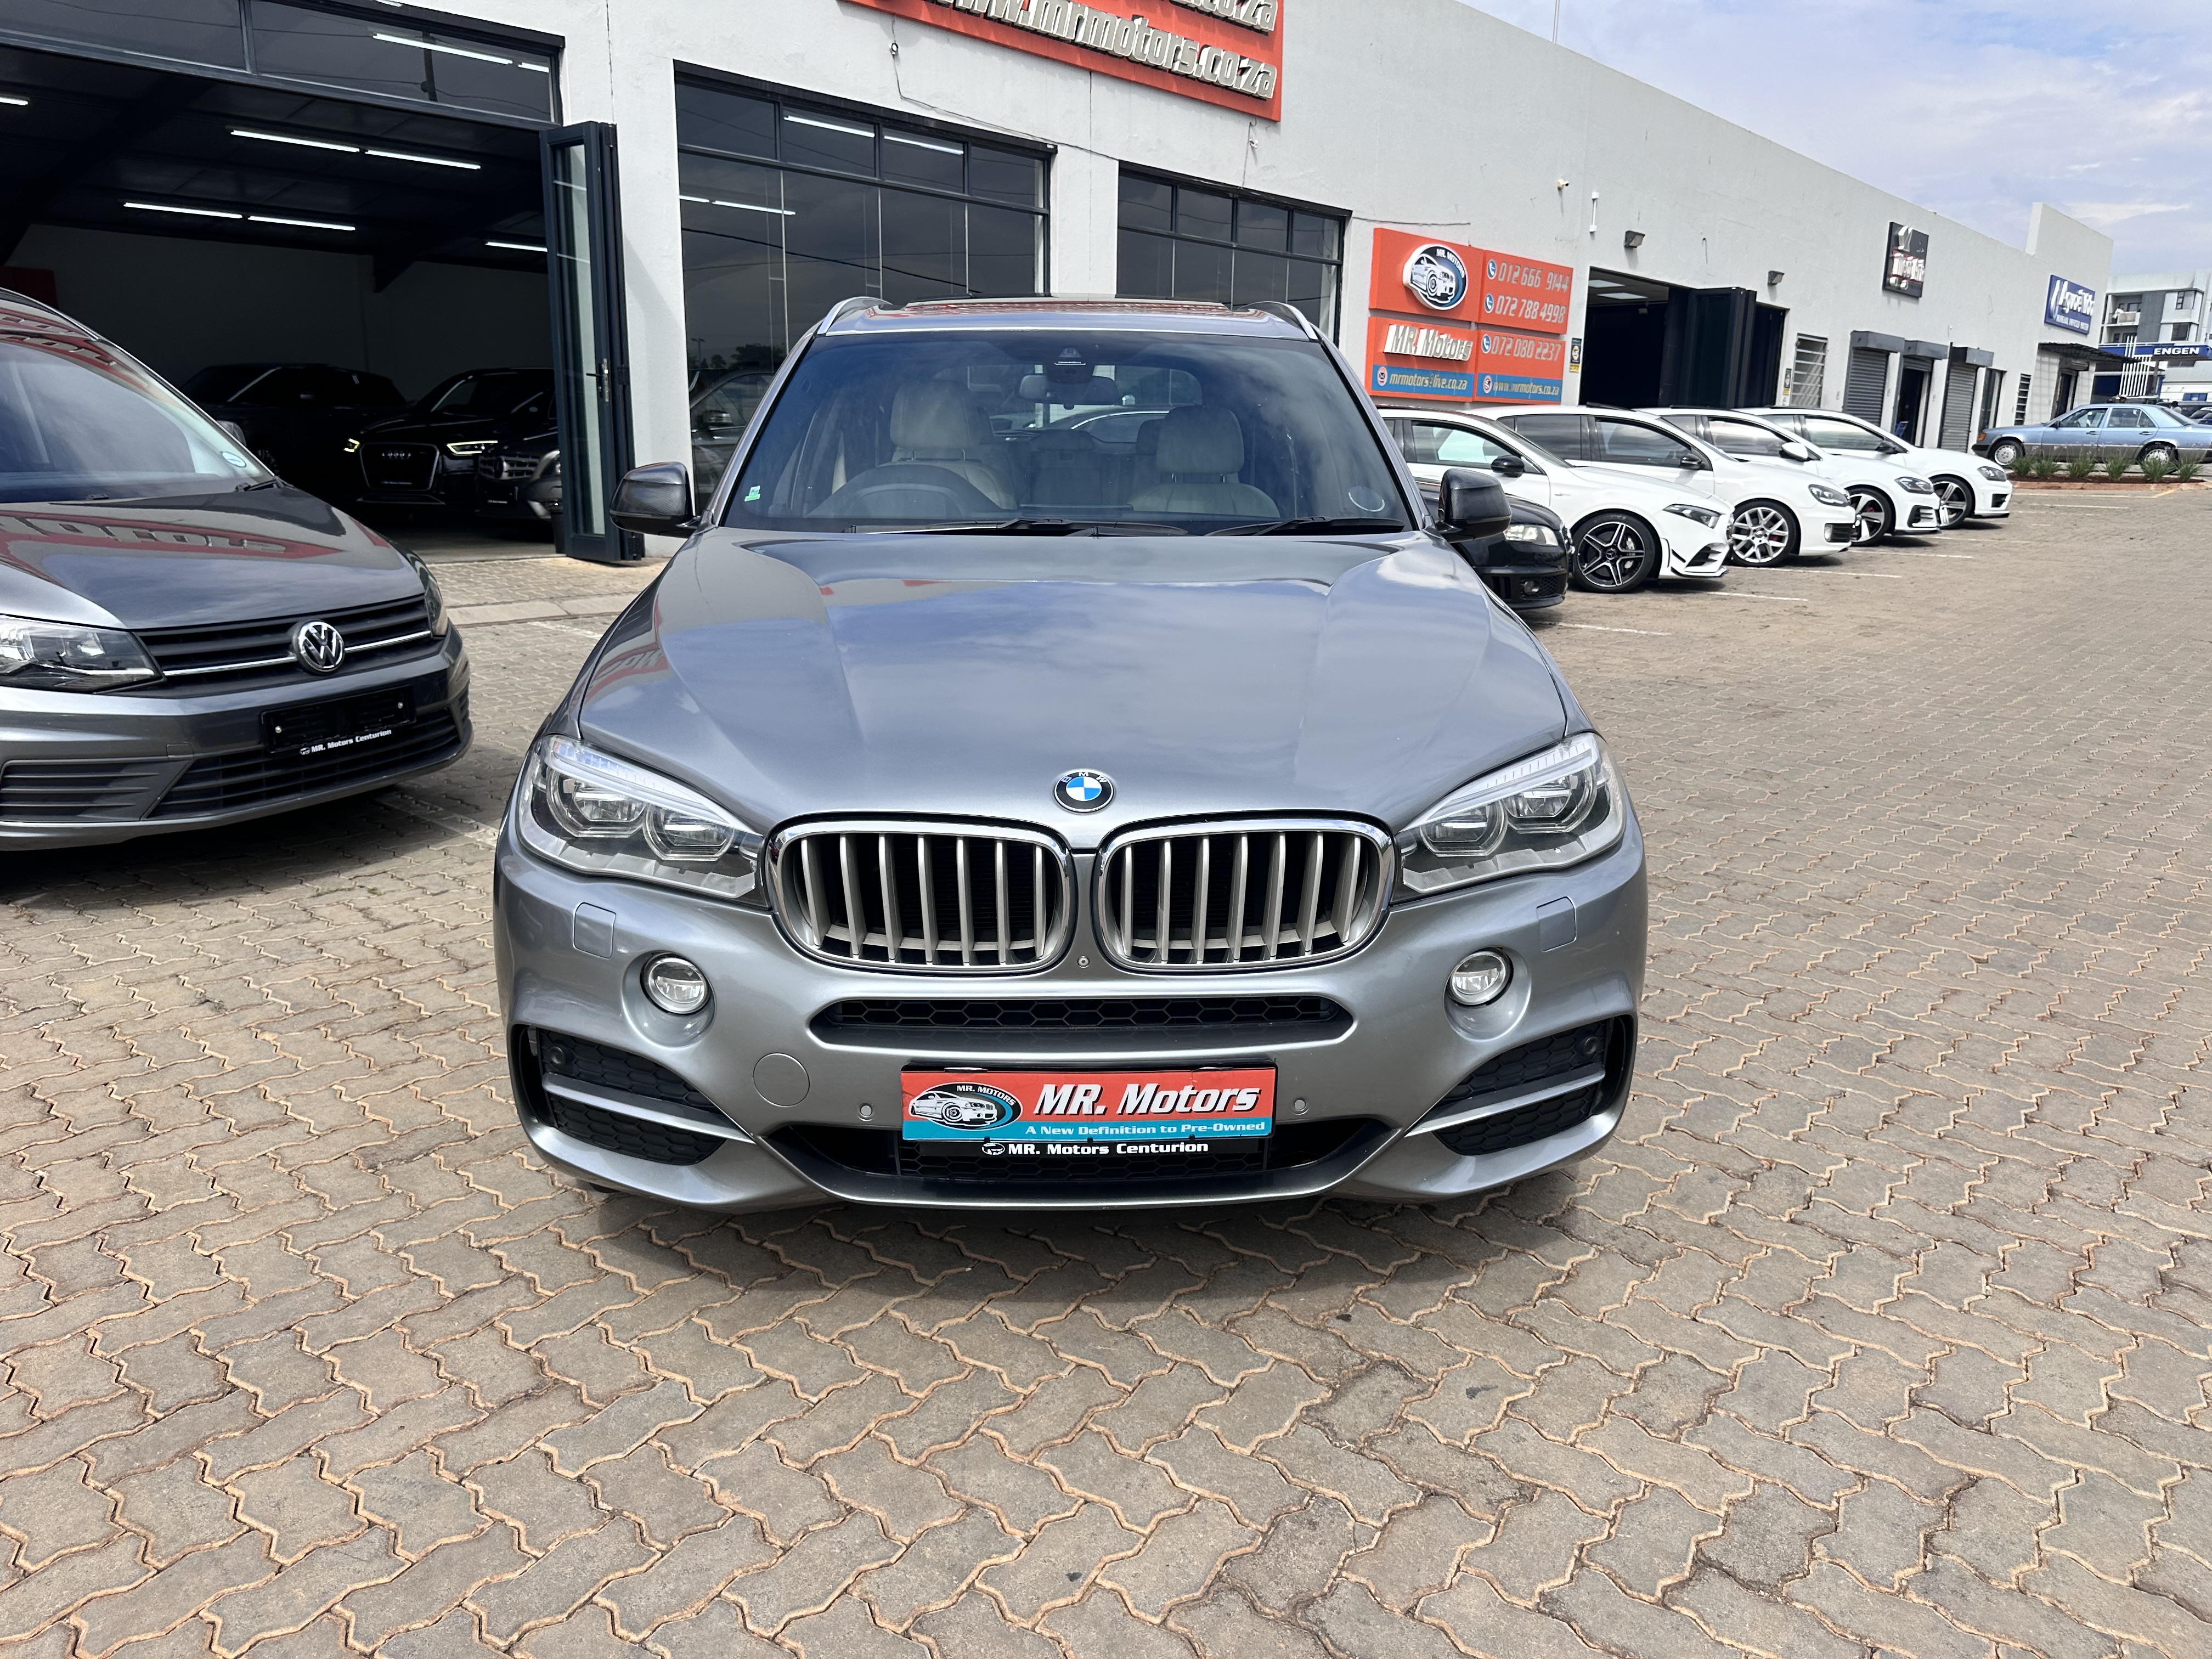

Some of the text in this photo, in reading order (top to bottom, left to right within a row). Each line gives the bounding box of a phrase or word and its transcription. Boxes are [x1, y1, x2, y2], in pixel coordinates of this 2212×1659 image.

[936, 0, 1277, 98] w.mrmotors.co.za
[1436, 249, 1465, 279] MR. MOTORS
[1498, 261, 1570, 293] 012 666 9144
[1494, 294, 1567, 324] 072 788 4998
[1383, 324, 1474, 362] MR. Motors
[1491, 335, 1562, 362] 072 080 2237
[2153, 347, 2200, 356] ENGEN
[1493, 381, 1560, 396] www.mrmotors.co.za
[311, 729, 392, 753] MR. Motors Centurion
[977, 1086, 1017, 1107] MOTORS
[1033, 1083, 1262, 1115] MR. Motors
[1025, 1121, 1266, 1136] A New Definition to Pre-Owned
[1008, 1142, 1209, 1155] MR. Motors Centurion
